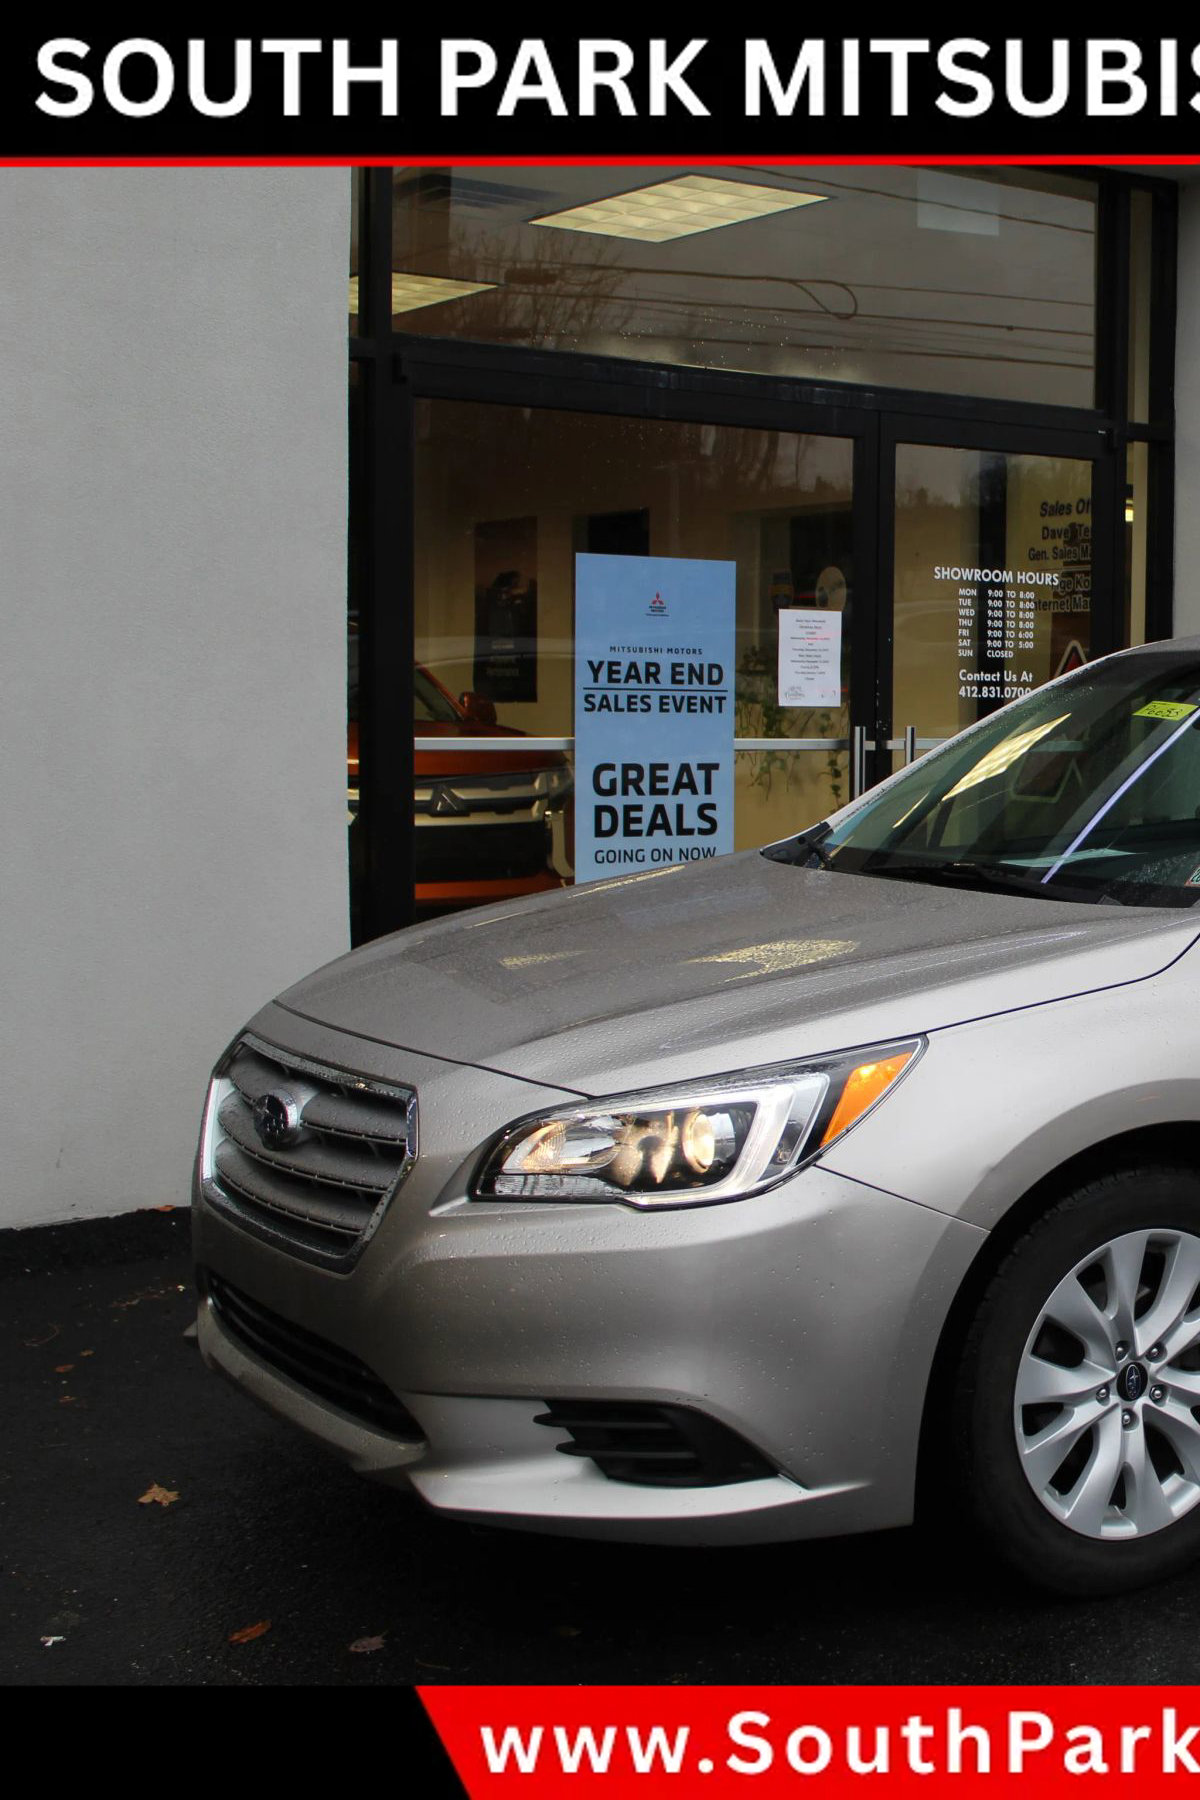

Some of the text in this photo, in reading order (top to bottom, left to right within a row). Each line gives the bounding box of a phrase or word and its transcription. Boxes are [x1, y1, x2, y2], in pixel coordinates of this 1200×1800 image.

[1040, 501, 1072, 517] Sales
[1042, 525, 1070, 540] Dave
[1028, 547, 1049, 561] Gen.
[1052, 545, 1078, 560] Sales
[933, 566, 1059, 586] SHOWROOM HOURS
[959, 588, 977, 596] MON
[987, 590, 1003, 598] 9:00
[1019, 591, 1035, 599] 8:00
[987, 600, 1003, 608] 9:00
[958, 608, 976, 616] WED
[987, 610, 1003, 618] 9:00
[1018, 611, 1034, 619] 8:00
[987, 620, 1003, 628] 9:00
[1018, 621, 1034, 629] 8:00
[1018, 631, 1034, 639] 6:00
[609, 645, 703, 656] MITSUBISHI MOTORS
[986, 640, 1002, 648] 9:00
[1018, 641, 1034, 649] 5:00
[958, 649, 1014, 658] SUN CLOSED
[587, 660, 724, 686] YEAR END
[959, 669, 1033, 682] Contact Us At
[583, 693, 727, 714] SALES EVENT
[592, 762, 720, 798] GREAT
[593, 803, 718, 839] DEALS
[594, 846, 717, 865] GOING ON NOW
